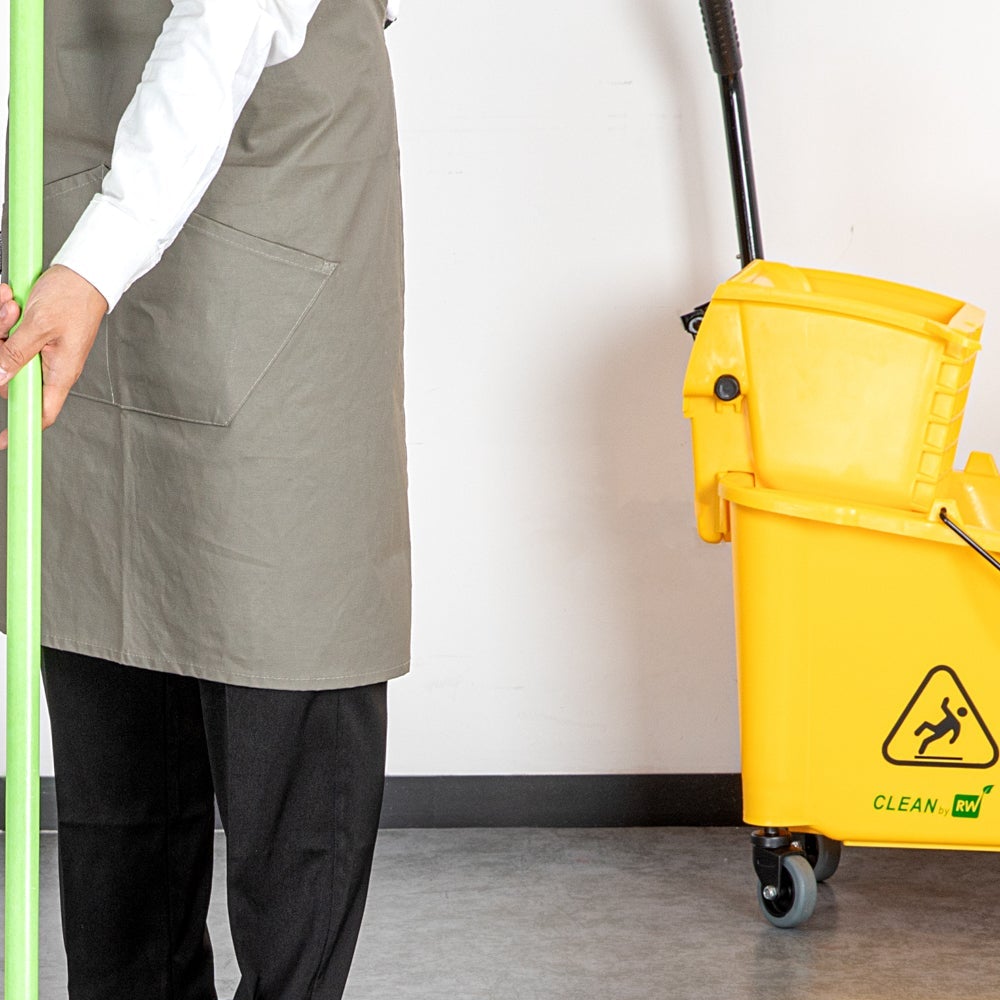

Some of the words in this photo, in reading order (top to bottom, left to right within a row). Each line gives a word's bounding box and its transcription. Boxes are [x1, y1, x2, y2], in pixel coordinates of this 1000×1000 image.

[873, 794, 938, 814] CLEAN
[938, 806, 950, 817] by
[954, 797, 979, 814] RW
